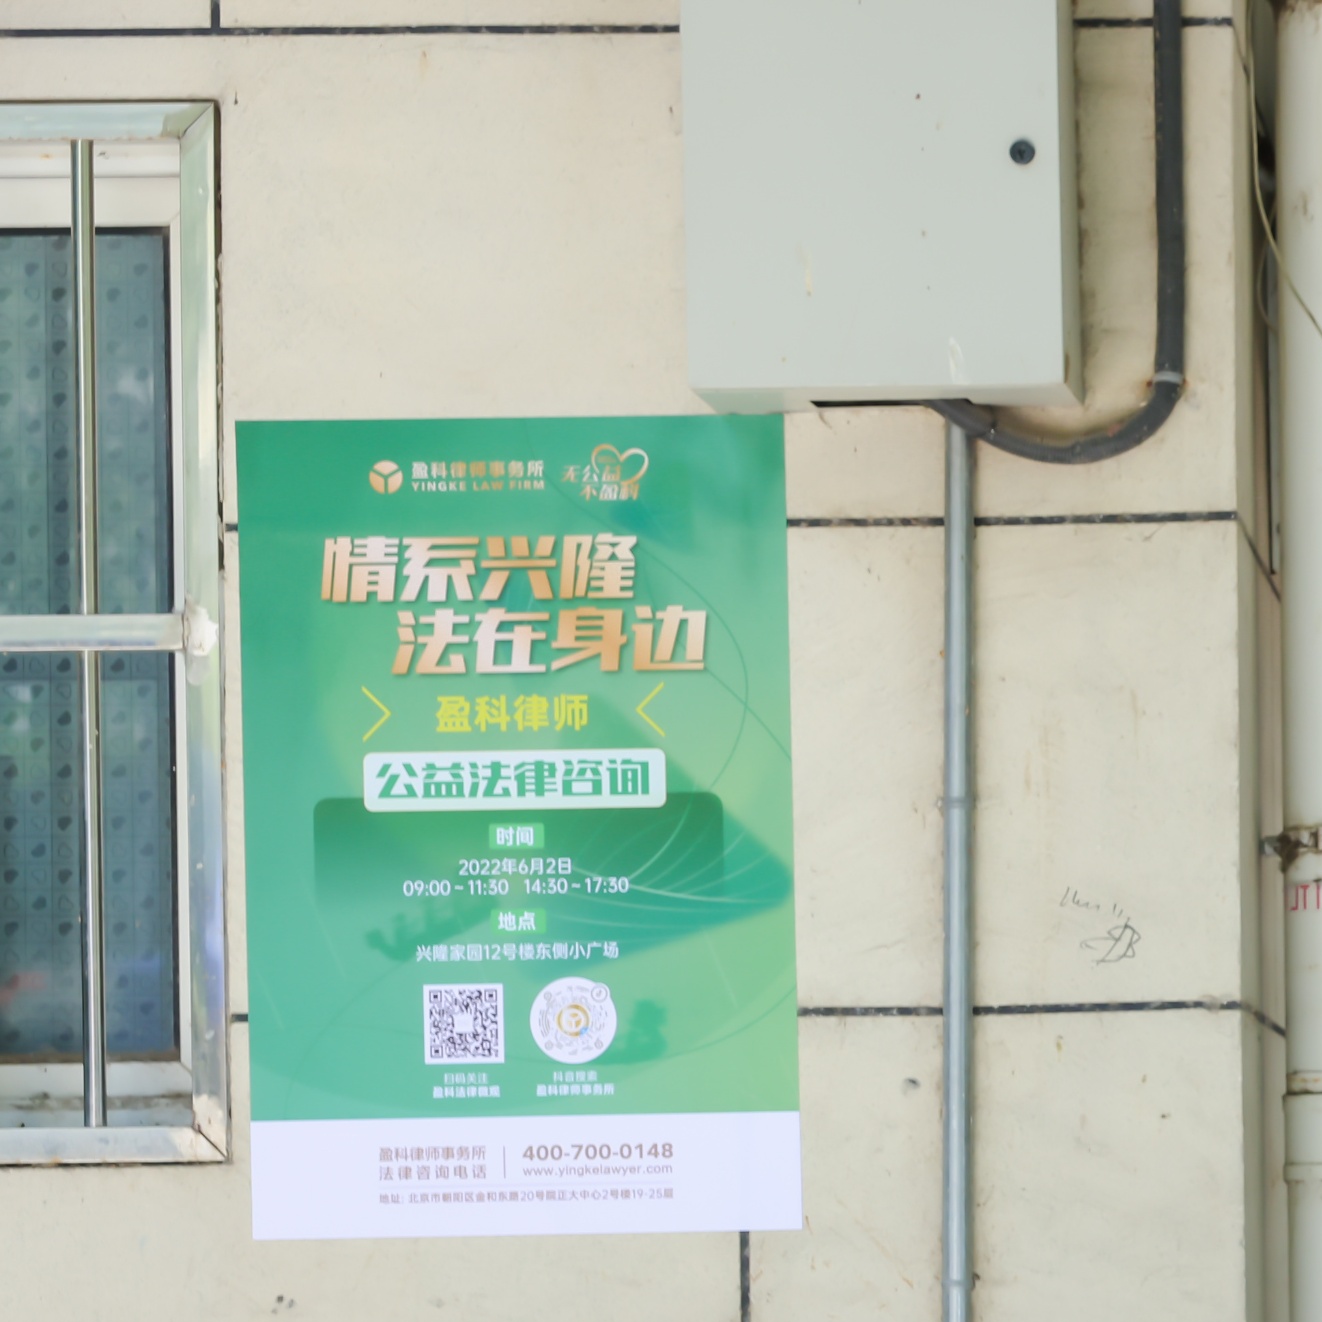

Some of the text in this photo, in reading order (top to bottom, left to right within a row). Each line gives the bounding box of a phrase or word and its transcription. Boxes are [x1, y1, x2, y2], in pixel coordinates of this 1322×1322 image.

[412, 460, 544, 479] 盈科律师事务所
[412, 479, 545, 492] YINGKE LAW FIRM
[321, 533, 638, 603] 情系兴隆
[391, 604, 708, 676] 法在身边
[435, 693, 589, 733] 盈科律师
[375, 758, 650, 800] 公益法律咨询
[496, 826, 535, 847] 时间
[458, 857, 572, 876] 2022年6月2日
[497, 911, 536, 932] 地点
[416, 941, 620, 962] 兴隆家园12号楼东侧小广场
[379, 1146, 486, 1162] 盈科律师事务所
[522, 1143, 674, 1161] 400-700-0148
[379, 1164, 487, 1181] 法律咨询电话
[522, 1163, 673, 1178] www.yingkelawyer.com
